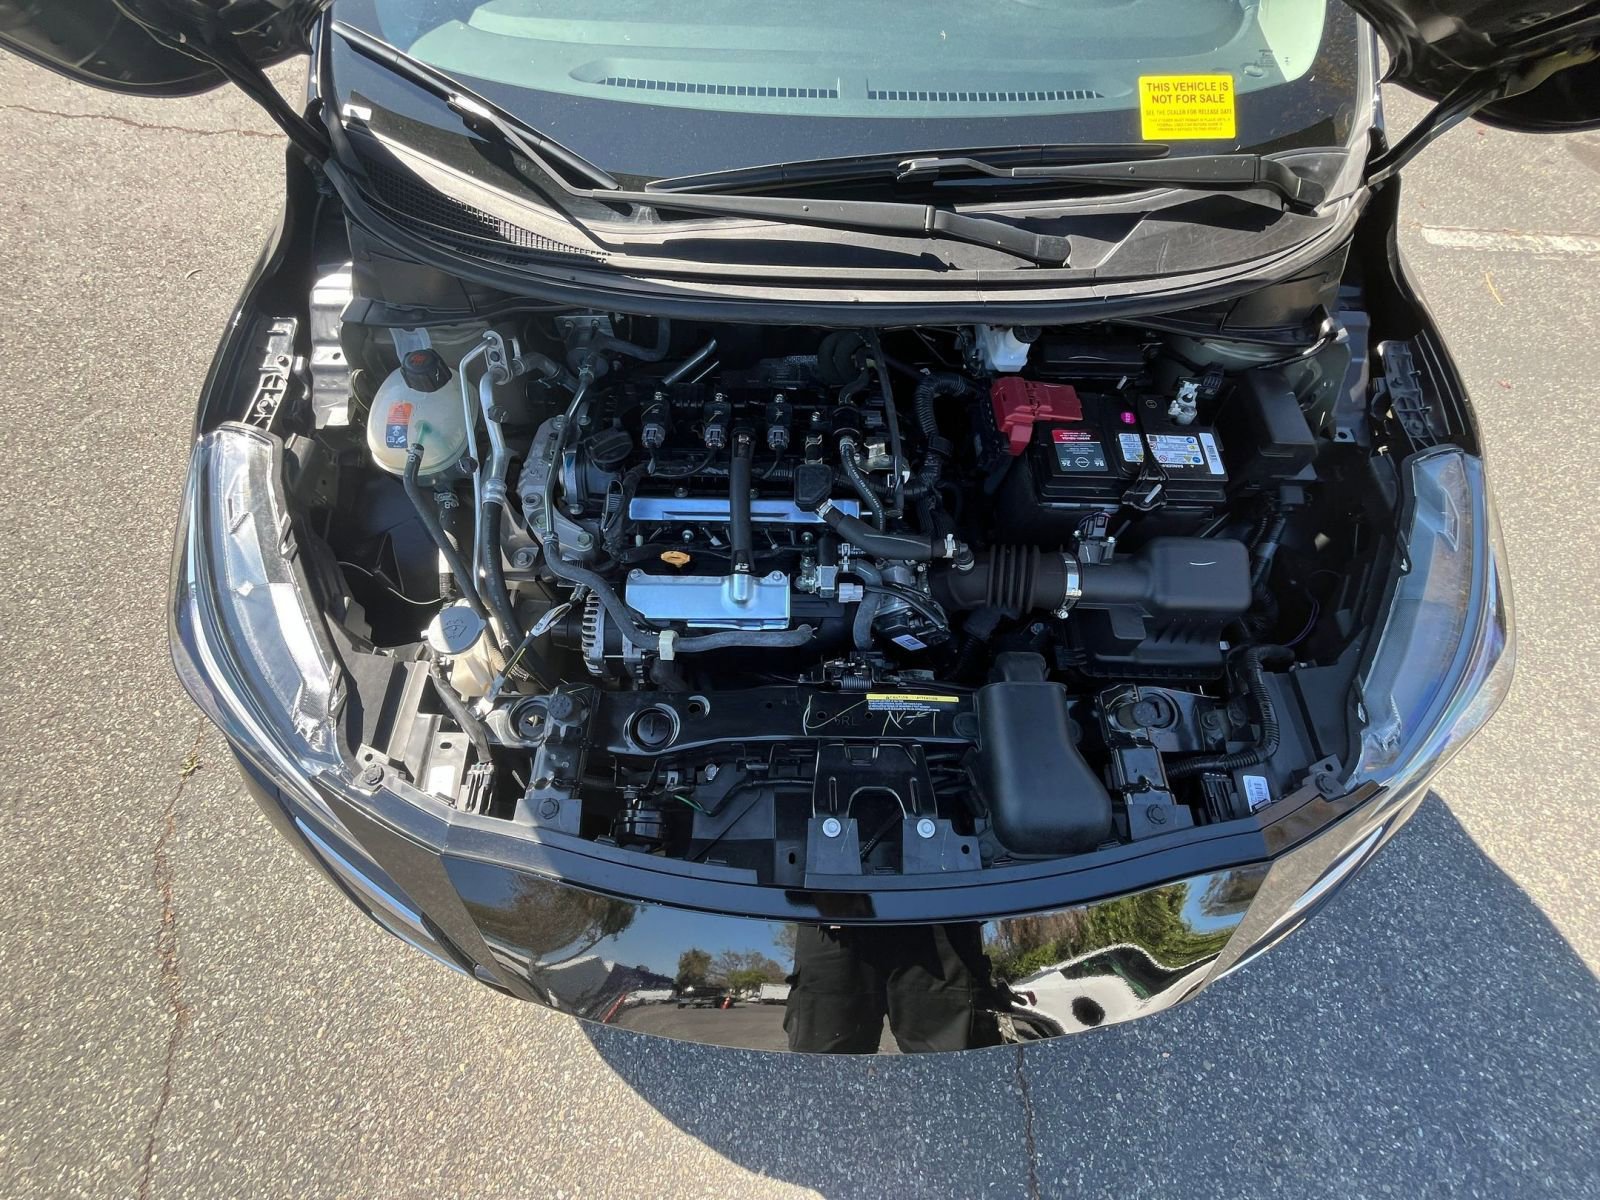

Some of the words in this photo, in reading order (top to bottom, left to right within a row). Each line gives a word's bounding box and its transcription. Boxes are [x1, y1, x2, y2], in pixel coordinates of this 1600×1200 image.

[1146, 82, 1170, 93] THIS
[1172, 81, 1217, 92] VEHICLE
[1219, 81, 1229, 92] IS
[1151, 94, 1173, 104] NOT
[1175, 94, 1197, 104] FOR
[1199, 93, 1225, 103] SALE
